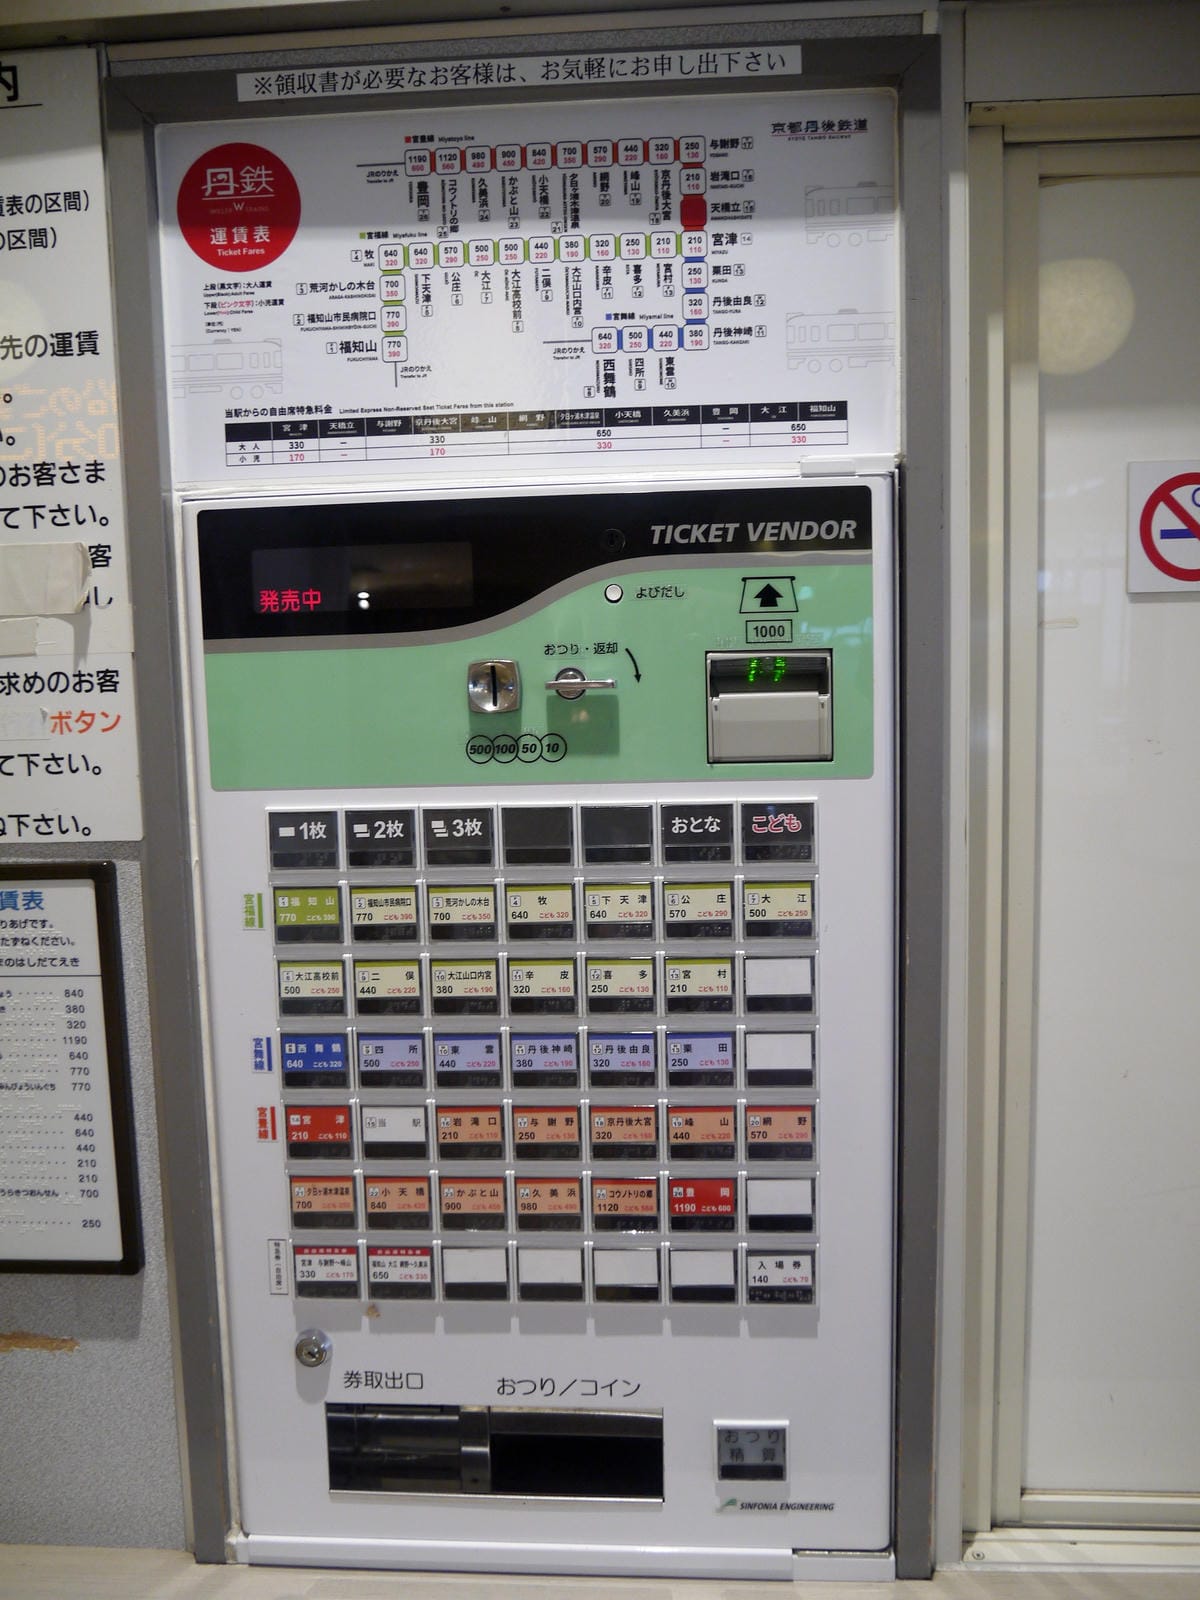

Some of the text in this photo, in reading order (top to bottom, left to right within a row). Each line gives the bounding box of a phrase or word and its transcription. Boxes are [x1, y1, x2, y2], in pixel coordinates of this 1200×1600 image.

[254, 51, 787, 96] ※領収書が必要なお客様は、お気軽にお申し出下さい
[771, 119, 867, 133] 京都丹後鉄道
[202, 165, 274, 196] 丹鉄
[417, 182, 429, 208] 豊岡
[509, 176, 519, 216] かぶと山
[210, 225, 270, 245] 運賃表
[712, 232, 738, 246] 宮津
[217, 248, 264, 257] Ticket Fares
[365, 250, 374, 260] 牧
[603, 266, 612, 286] 辛皮
[633, 264, 642, 284] 喜多
[664, 264, 672, 284] 宮村
[451, 272, 461, 292] 公庄
[482, 271, 490, 290] 大江
[309, 281, 375, 292] 荒河かしの木台
[512, 270, 522, 320] 大江高校前
[712, 296, 752, 307] 丹後由良
[308, 312, 376, 323] 福知山市民病院口
[713, 327, 752, 338] 丹後神崎
[0, 331, 99, 360] 先の運賃
[339, 342, 377, 354] 福知山
[635, 358, 644, 377] 四所
[603, 358, 616, 398] 西舞鶴
[225, 404, 332, 418] 当駅からの自由席特急料金
[597, 429, 611, 437] 650
[3, 504, 109, 528] て下さい。
[651, 520, 857, 544] TICKET VENDOR
[636, 586, 684, 598] よびだし
[260, 589, 322, 614] 発売中
[753, 625, 785, 637] 1000
[544, 642, 618, 655] おつり・返却
[0, 670, 120, 695] 求めのお客
[51, 710, 122, 735] ボタン
[470, 744, 492, 755] 500
[495, 744, 516, 754] 100
[522, 743, 537, 753] 50
[545, 742, 559, 752] 10
[0, 752, 101, 777] て下さい。
[452, 818, 482, 837] 3枚
[672, 816, 720, 833] おとな
[752, 814, 801, 833] こども
[299, 822, 326, 840] 1枚
[374, 820, 404, 838] 2枚
[445, 898, 489, 906] 荒河かしの木台
[538, 896, 547, 905] 牧
[356, 913, 372, 921] 770
[512, 911, 528, 919] 640
[590, 910, 606, 918] 640
[670, 910, 686, 918] 570
[750, 909, 766, 917] 500
[1, 937, 76, 946] たずねください。
[296, 972, 339, 980] 大江高校前
[448, 970, 492, 980] 大江山口内宮
[285, 986, 300, 994] 500
[360, 986, 376, 994] 440
[592, 985, 608, 993] 250
[671, 984, 687, 992] 210
[65, 989, 83, 998] 840
[66, 1005, 85, 1013] 380
[67, 1021, 86, 1029] 320
[63, 1036, 87, 1044] 1190
[528, 1044, 572, 1054] 丹後神崎
[605, 1044, 650, 1054] 丹後由良
[69, 1052, 88, 1060] 640
[287, 1060, 303, 1068] 640
[364, 1059, 379, 1067] 500
[517, 1059, 532, 1067] 380
[594, 1059, 609, 1067] 320
[672, 1058, 688, 1066] 250
[72, 1083, 90, 1091] 770
[74, 1114, 93, 1122] 440
[607, 1117, 652, 1126] 京丹後大宮
[292, 1132, 308, 1140] 210
[673, 1132, 689, 1140] 440
[751, 1131, 767, 1139] 570
[77, 1144, 95, 1152] 440
[78, 1159, 96, 1167] 210
[80, 1190, 99, 1198] 700
[457, 1188, 498, 1197] かぶと山
[445, 1202, 461, 1210] 900
[675, 1204, 696, 1212] 1190
[82, 1220, 101, 1228] 250
[373, 1272, 388, 1280] 650
[343, 1371, 424, 1390] 券取出口
[496, 1378, 640, 1396] おつり／コイン
[740, 1502, 834, 1510] SINFONIA ENGINEERING
